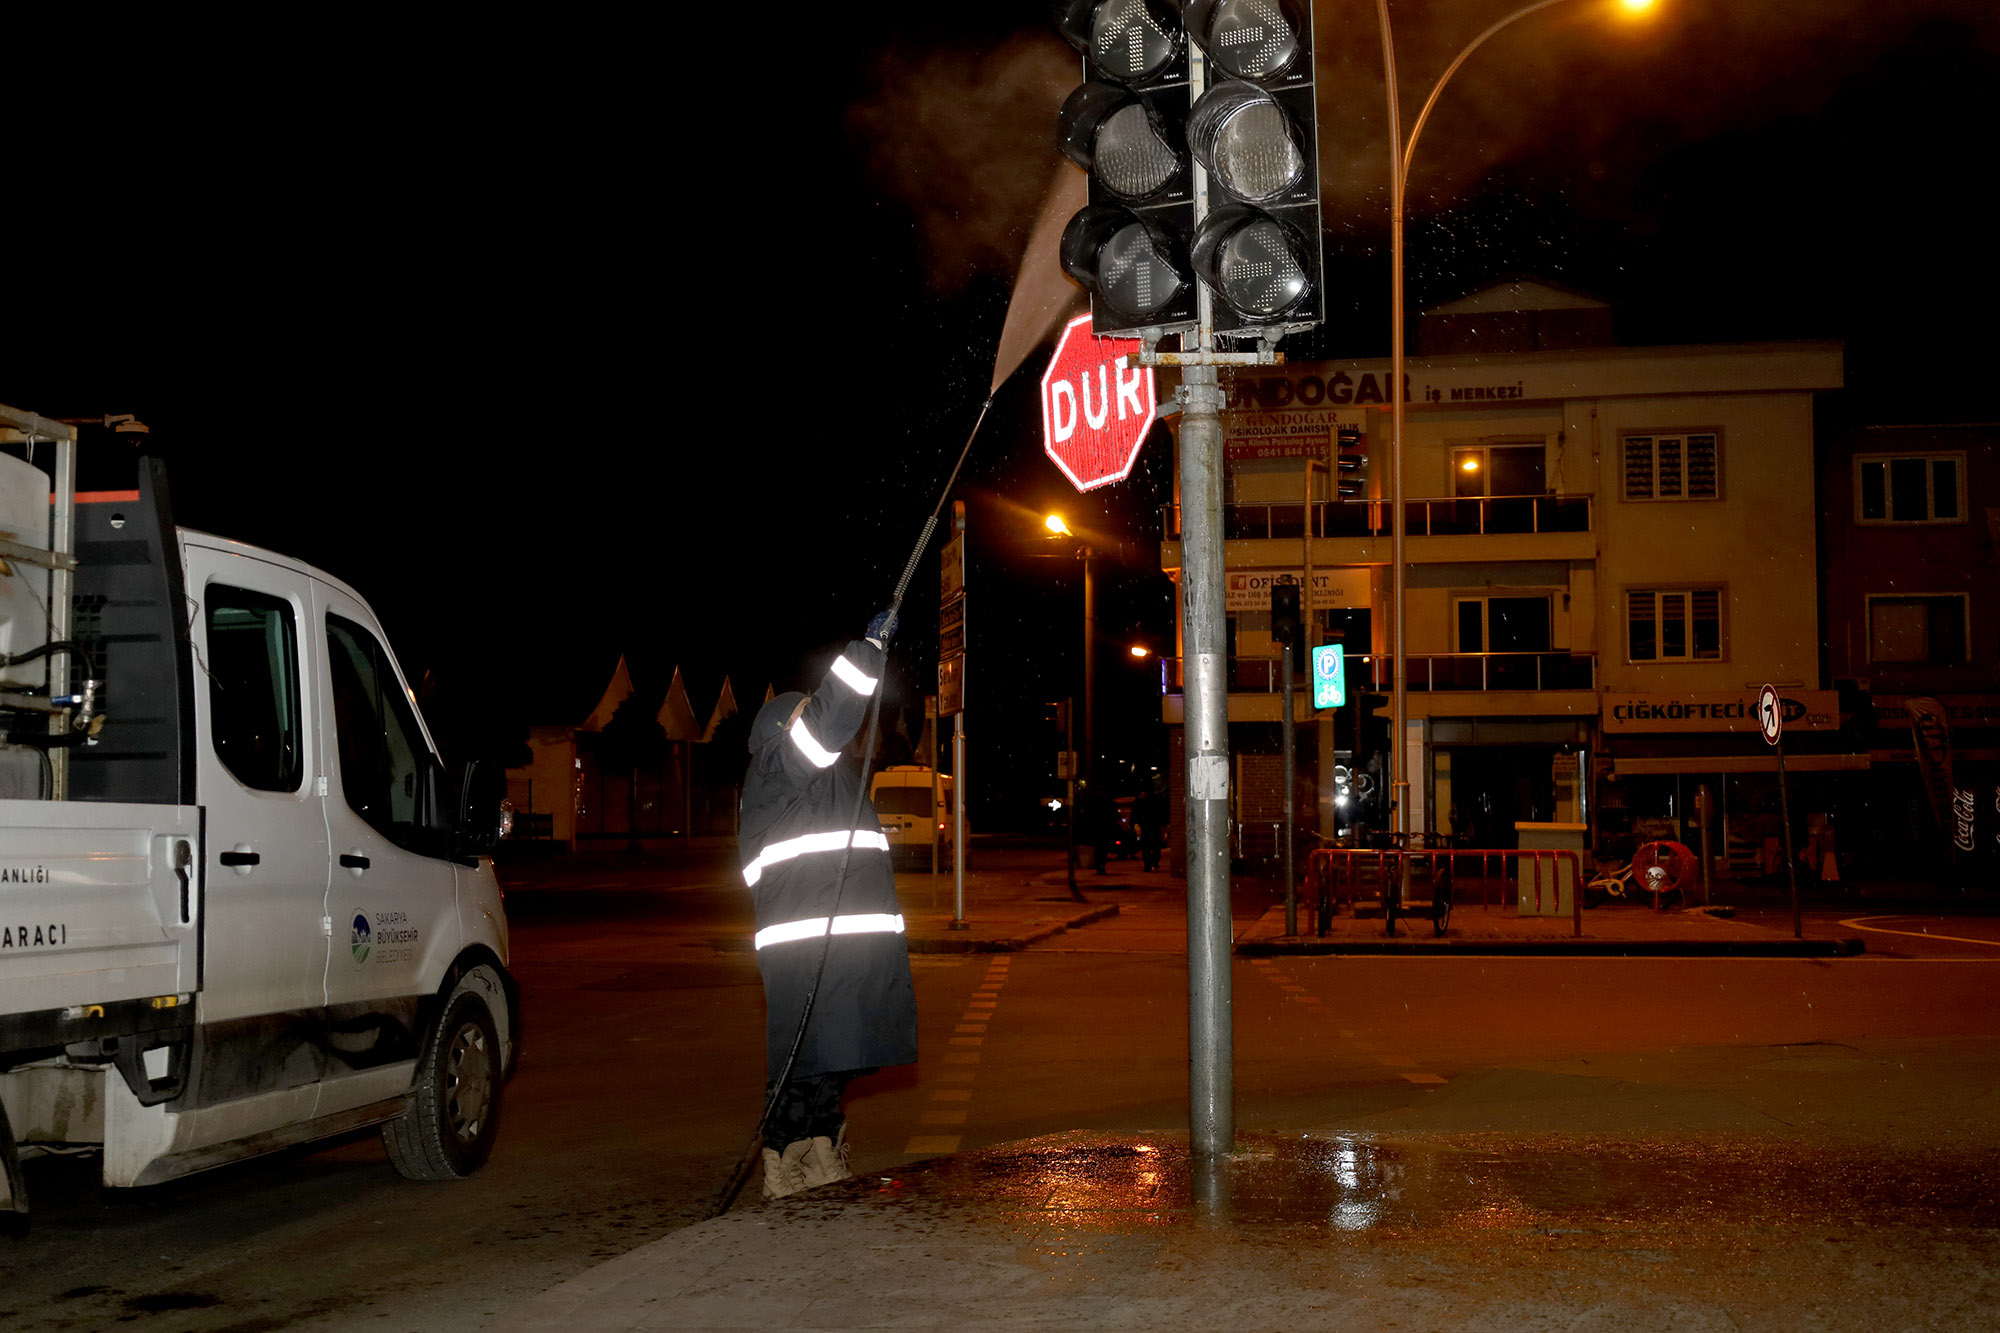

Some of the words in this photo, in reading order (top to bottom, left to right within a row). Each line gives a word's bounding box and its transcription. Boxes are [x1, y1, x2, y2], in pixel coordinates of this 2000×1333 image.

[1051, 355, 1143, 443] DUR
[1450, 380, 1523, 401] MERKEZİ
[1290, 423, 1359, 434] DANIŞMNLIK
[1257, 448, 1281, 457] 0541
[1284, 447, 1303, 456] 844
[1306, 447, 1315, 455] 11
[1272, 437, 1304, 448] Psikolog
[1323, 655, 1334, 674] P
[1614, 698, 1744, 724] ÇİĞKÖFTECİ
[1953, 785, 1976, 852] Coca-Cola
[375, 912, 408, 926] SAKARYA
[2, 924, 66, 948] ARACI
[376, 926, 419, 945] BÜYÜKŞEHİR
